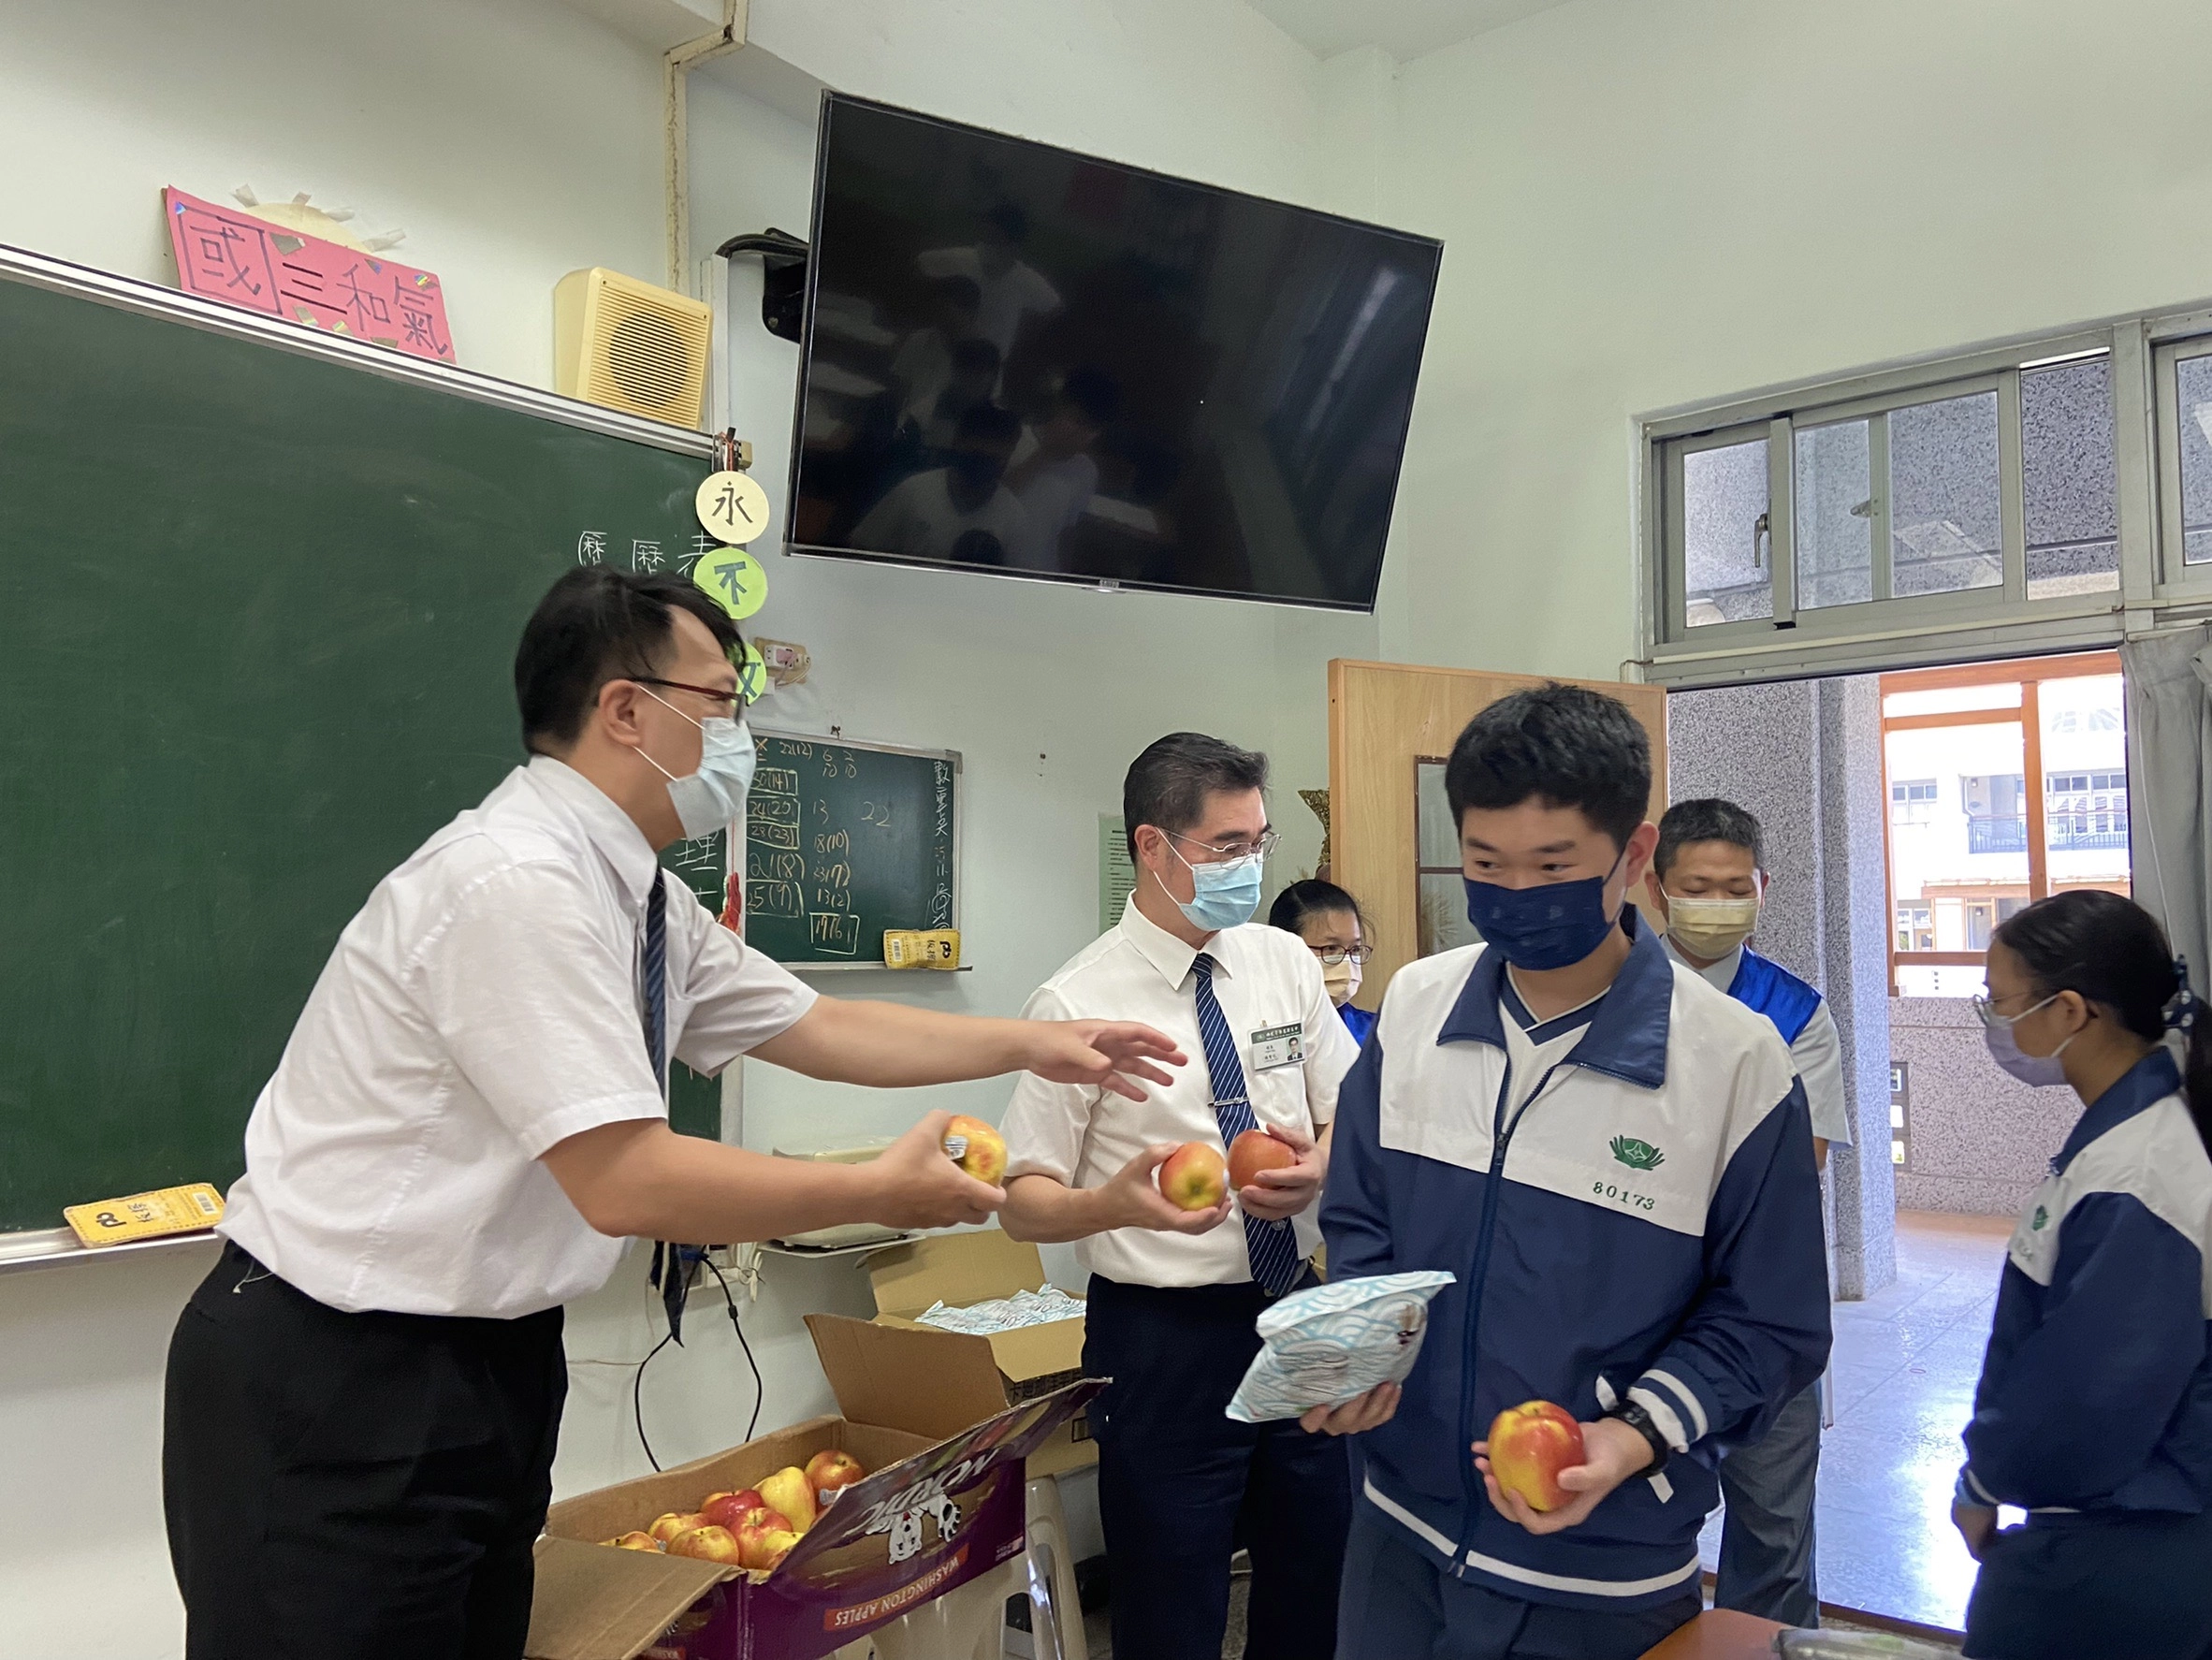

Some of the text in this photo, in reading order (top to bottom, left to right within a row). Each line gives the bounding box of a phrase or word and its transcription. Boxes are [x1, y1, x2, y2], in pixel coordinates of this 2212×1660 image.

[711, 481, 753, 527] 永
[714, 561, 748, 605] 不
[1593, 1181, 1656, 1211] 80173
[835, 1556, 960, 1626] WASHINGTON APPLES
